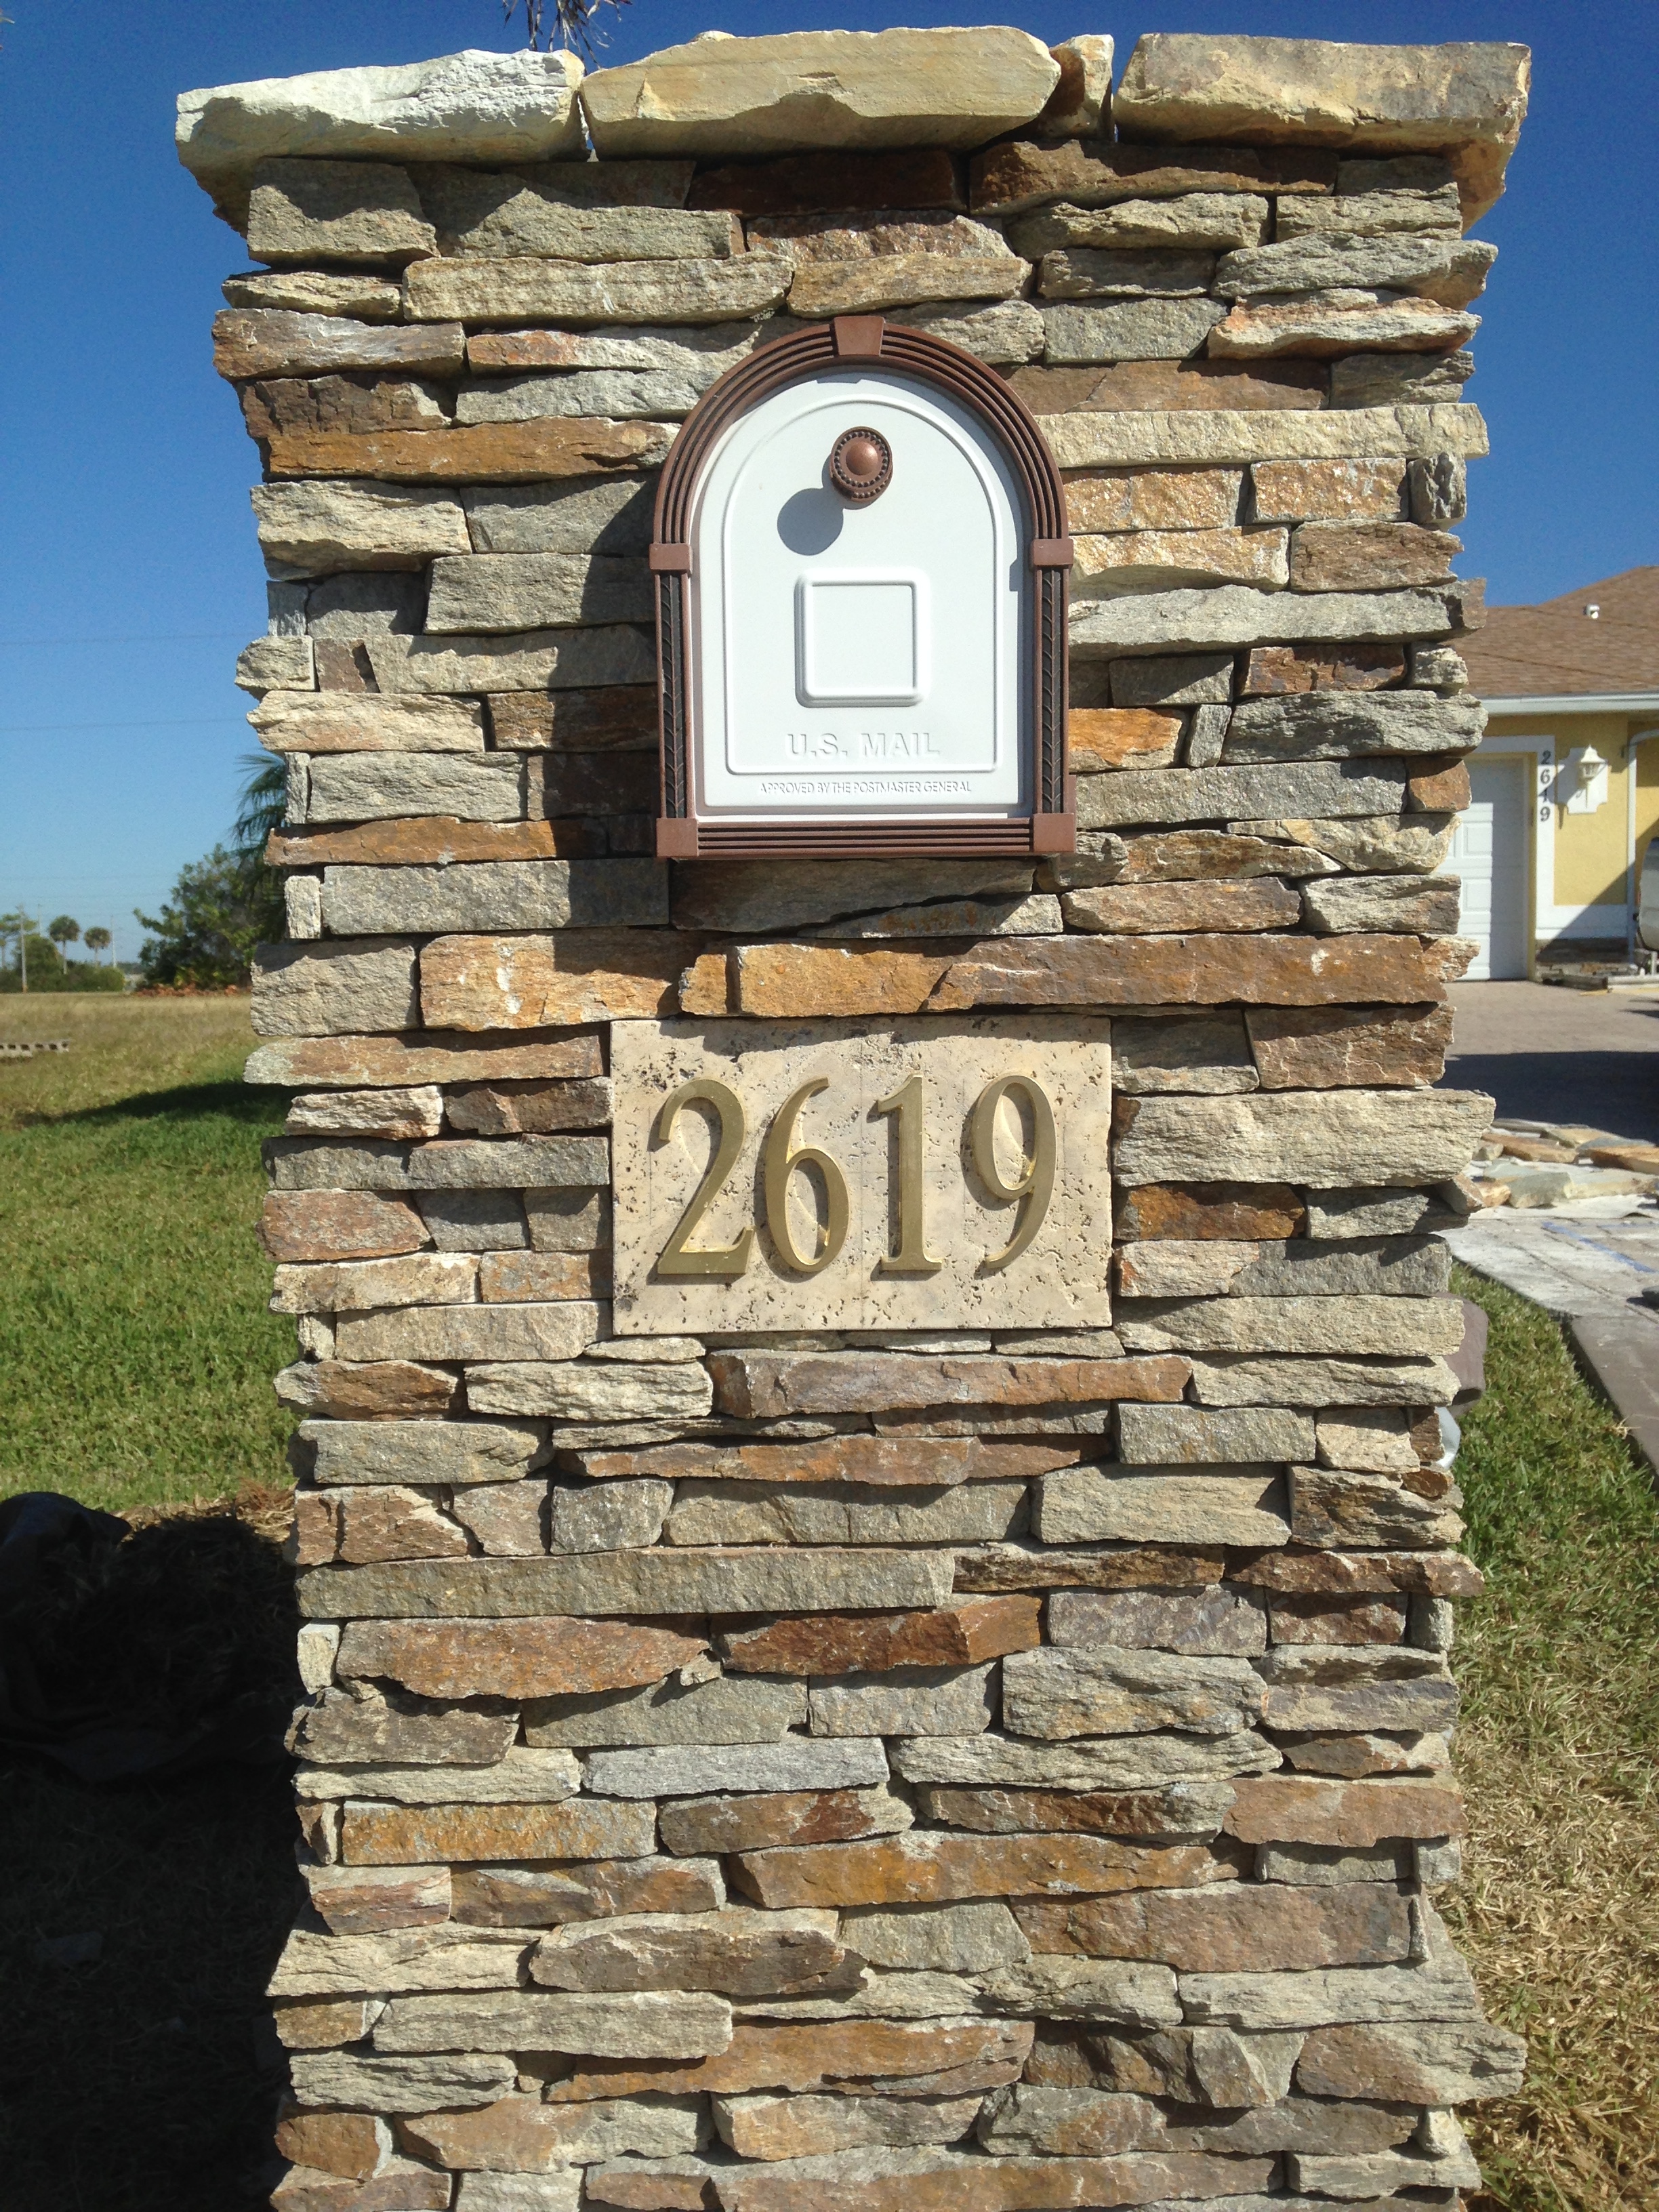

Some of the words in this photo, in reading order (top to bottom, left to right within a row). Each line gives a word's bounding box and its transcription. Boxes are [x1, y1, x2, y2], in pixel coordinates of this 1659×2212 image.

[787, 733, 848, 758] U.S.
[860, 732, 941, 757] MAIL
[760, 782, 815, 794] APPROVED
[817, 782, 830, 794] BY
[832, 781, 851, 793] THE
[853, 781, 922, 793] POSTMASTER
[923, 781, 972, 792] GENERAL
[1540, 750, 1551, 822] 2619
[656, 1073, 1057, 1275] 2619
